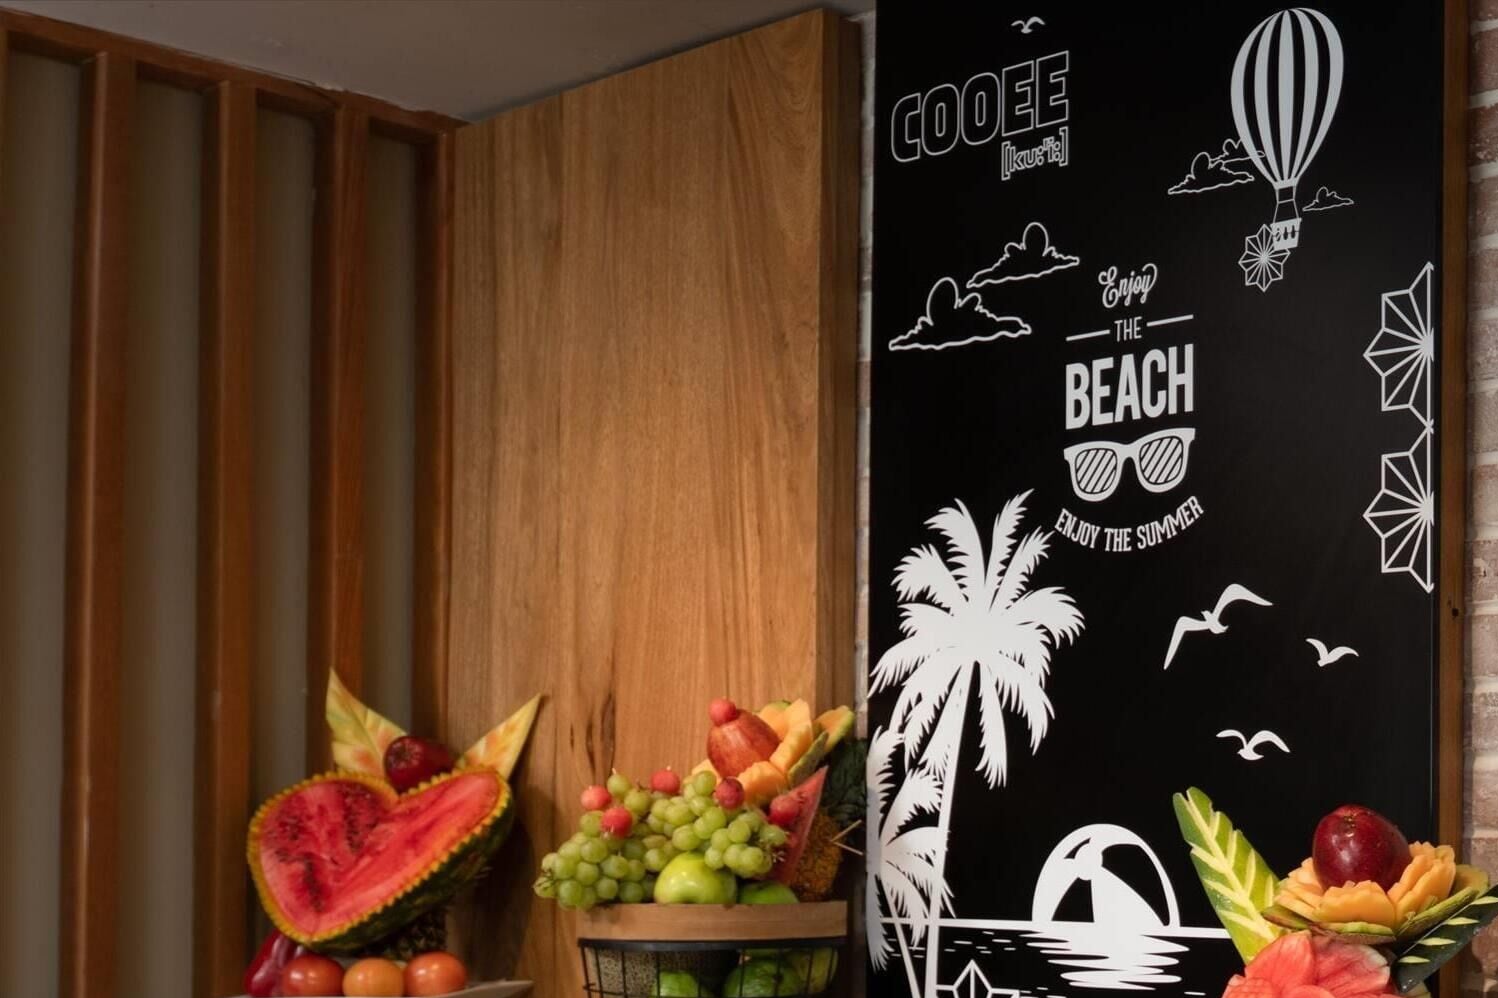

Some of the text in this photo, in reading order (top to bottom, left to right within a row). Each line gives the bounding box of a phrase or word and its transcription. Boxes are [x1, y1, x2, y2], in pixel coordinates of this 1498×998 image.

[891, 50, 1069, 163] COOEE
[1098, 263, 1158, 309] Enjoy
[1114, 316, 1143, 342] THE
[1065, 343, 1194, 430] BEACH
[1054, 495, 1204, 552] ENJOY THE SUMMER
